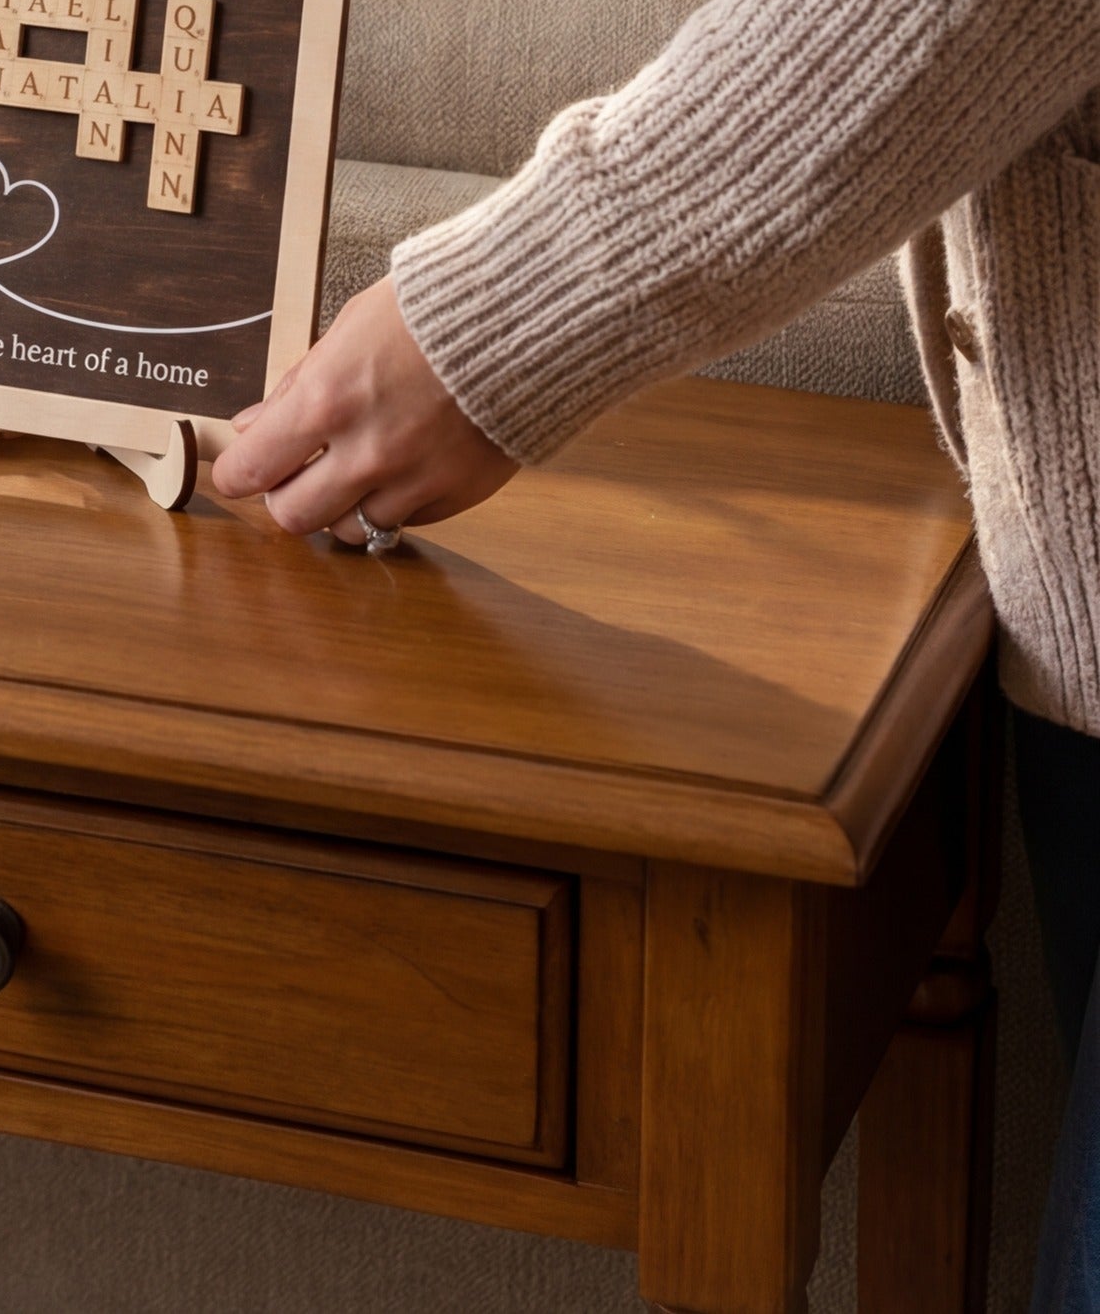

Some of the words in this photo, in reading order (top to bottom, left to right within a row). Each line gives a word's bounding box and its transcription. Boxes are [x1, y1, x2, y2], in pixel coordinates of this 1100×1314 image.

[161, 4, 197, 199] QUINN
[11, 335, 77, 368] heart
[84, 348, 111, 372] of
[115, 358, 129, 376] a
[136, 352, 210, 387] home
